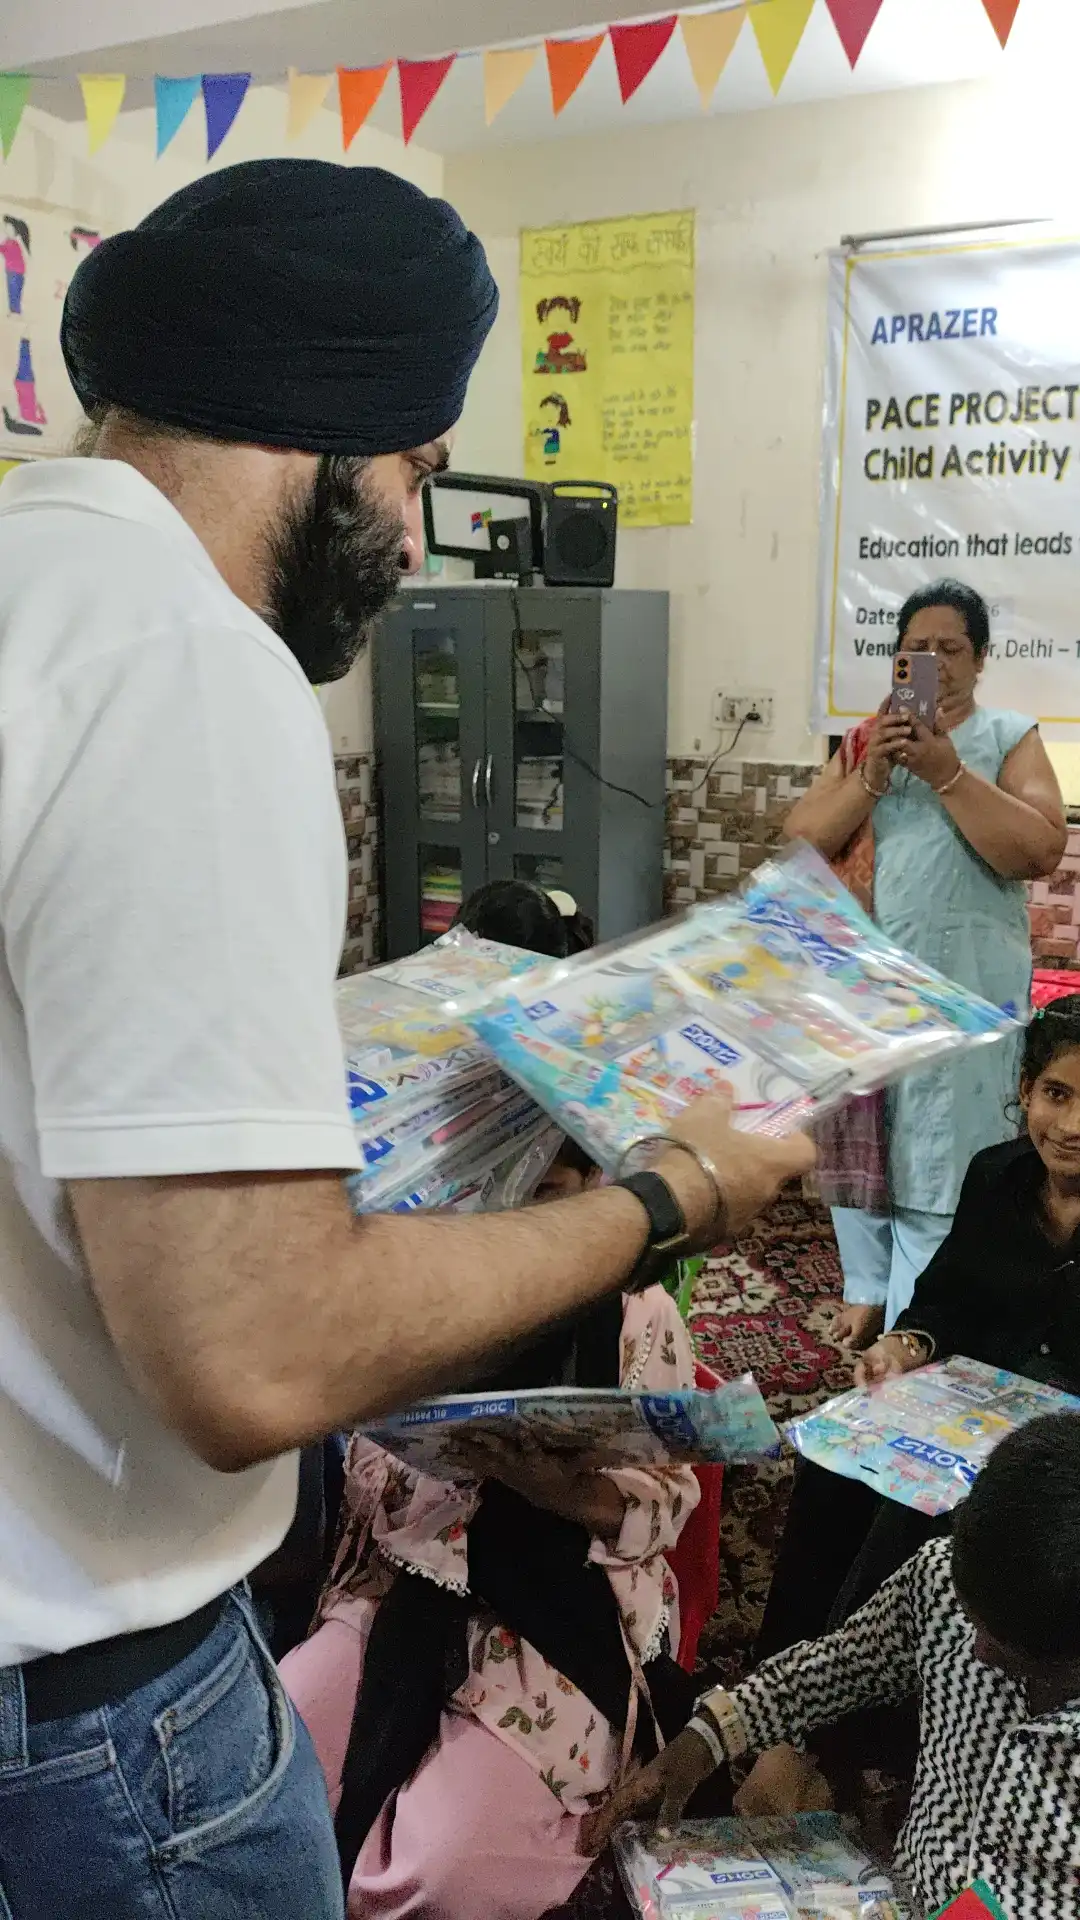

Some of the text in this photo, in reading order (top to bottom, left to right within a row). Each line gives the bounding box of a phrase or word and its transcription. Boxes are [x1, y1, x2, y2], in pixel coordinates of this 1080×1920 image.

[871, 306, 998, 346] APRAZER
[865, 384, 1080, 431] PACE PROJECT
[864, 439, 1072, 481] Child Activity
[859, 532, 1073, 559] Education that leads
[854, 639, 898, 657] Venu
[1005, 638, 1054, 658] Delhi
[471, 1401, 508, 1416] DOMS
[894, 1439, 980, 1489] DOMS
[714, 1869, 771, 1884] DOMS
